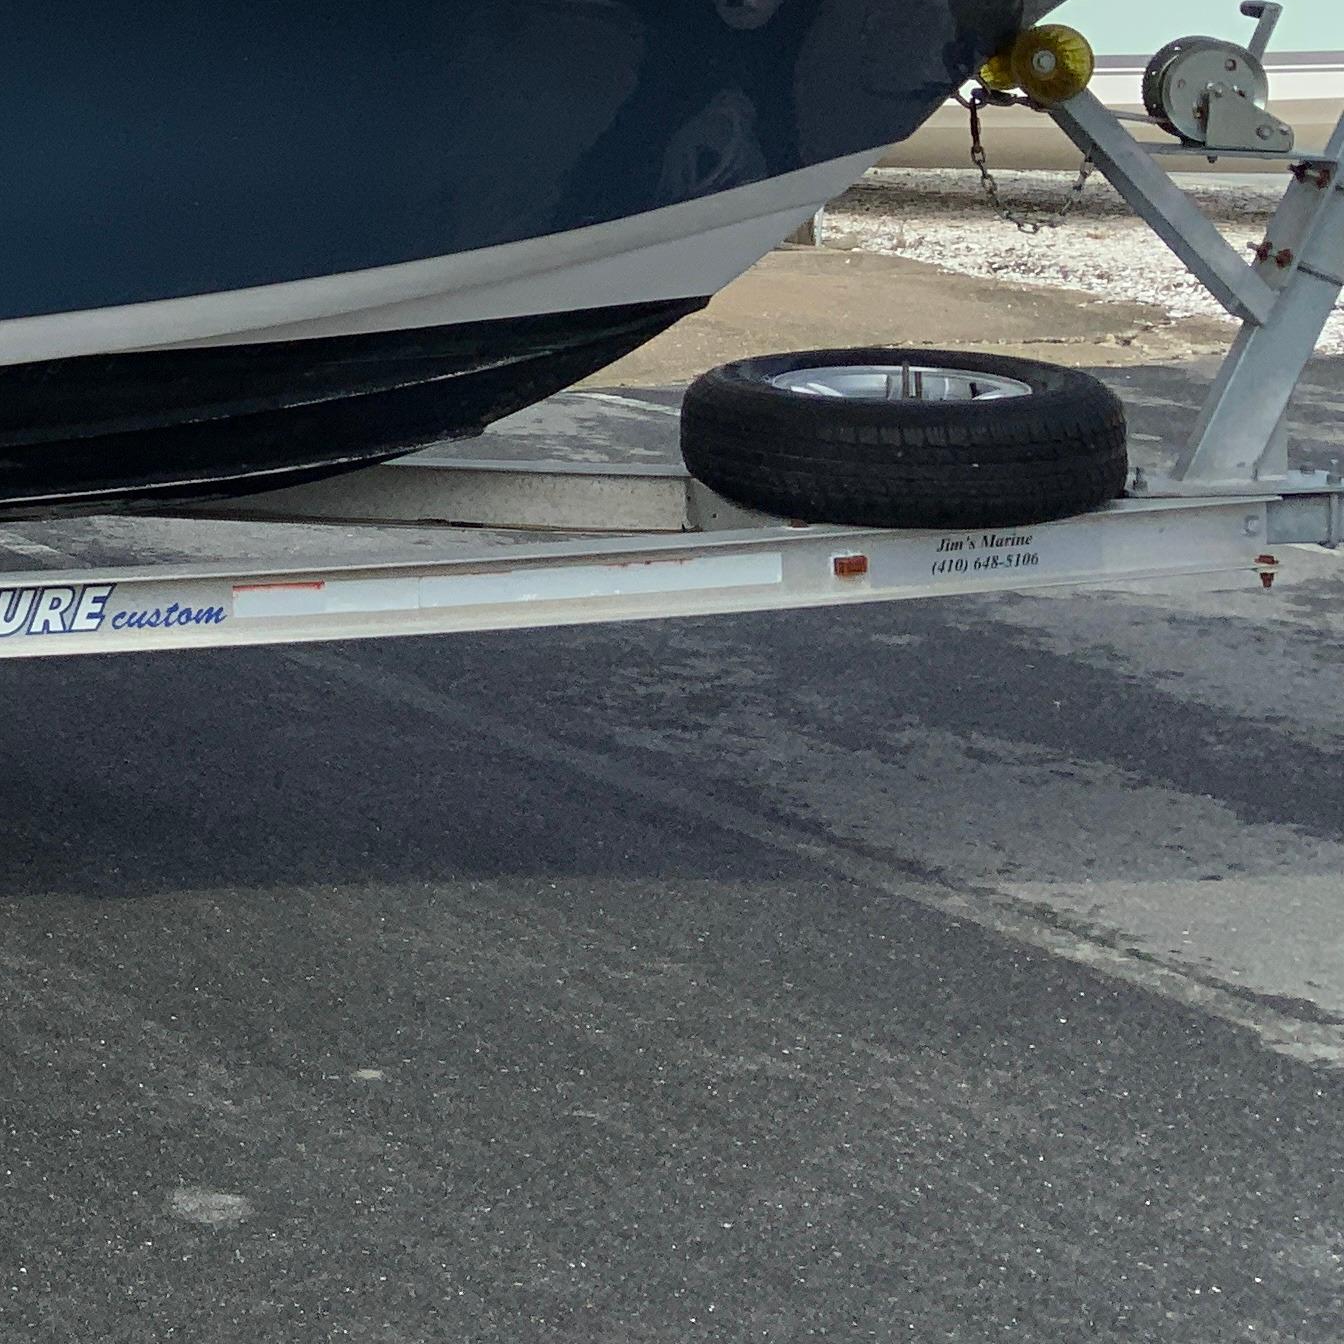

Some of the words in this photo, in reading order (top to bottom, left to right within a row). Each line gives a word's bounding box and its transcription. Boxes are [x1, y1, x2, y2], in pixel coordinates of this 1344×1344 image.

[936, 535, 976, 553] Jim's
[980, 533, 1033, 549] Marine
[931, 558, 969, 576] (410)
[972, 552, 1040, 572] 648-5106
[111, 601, 227, 631] custom
